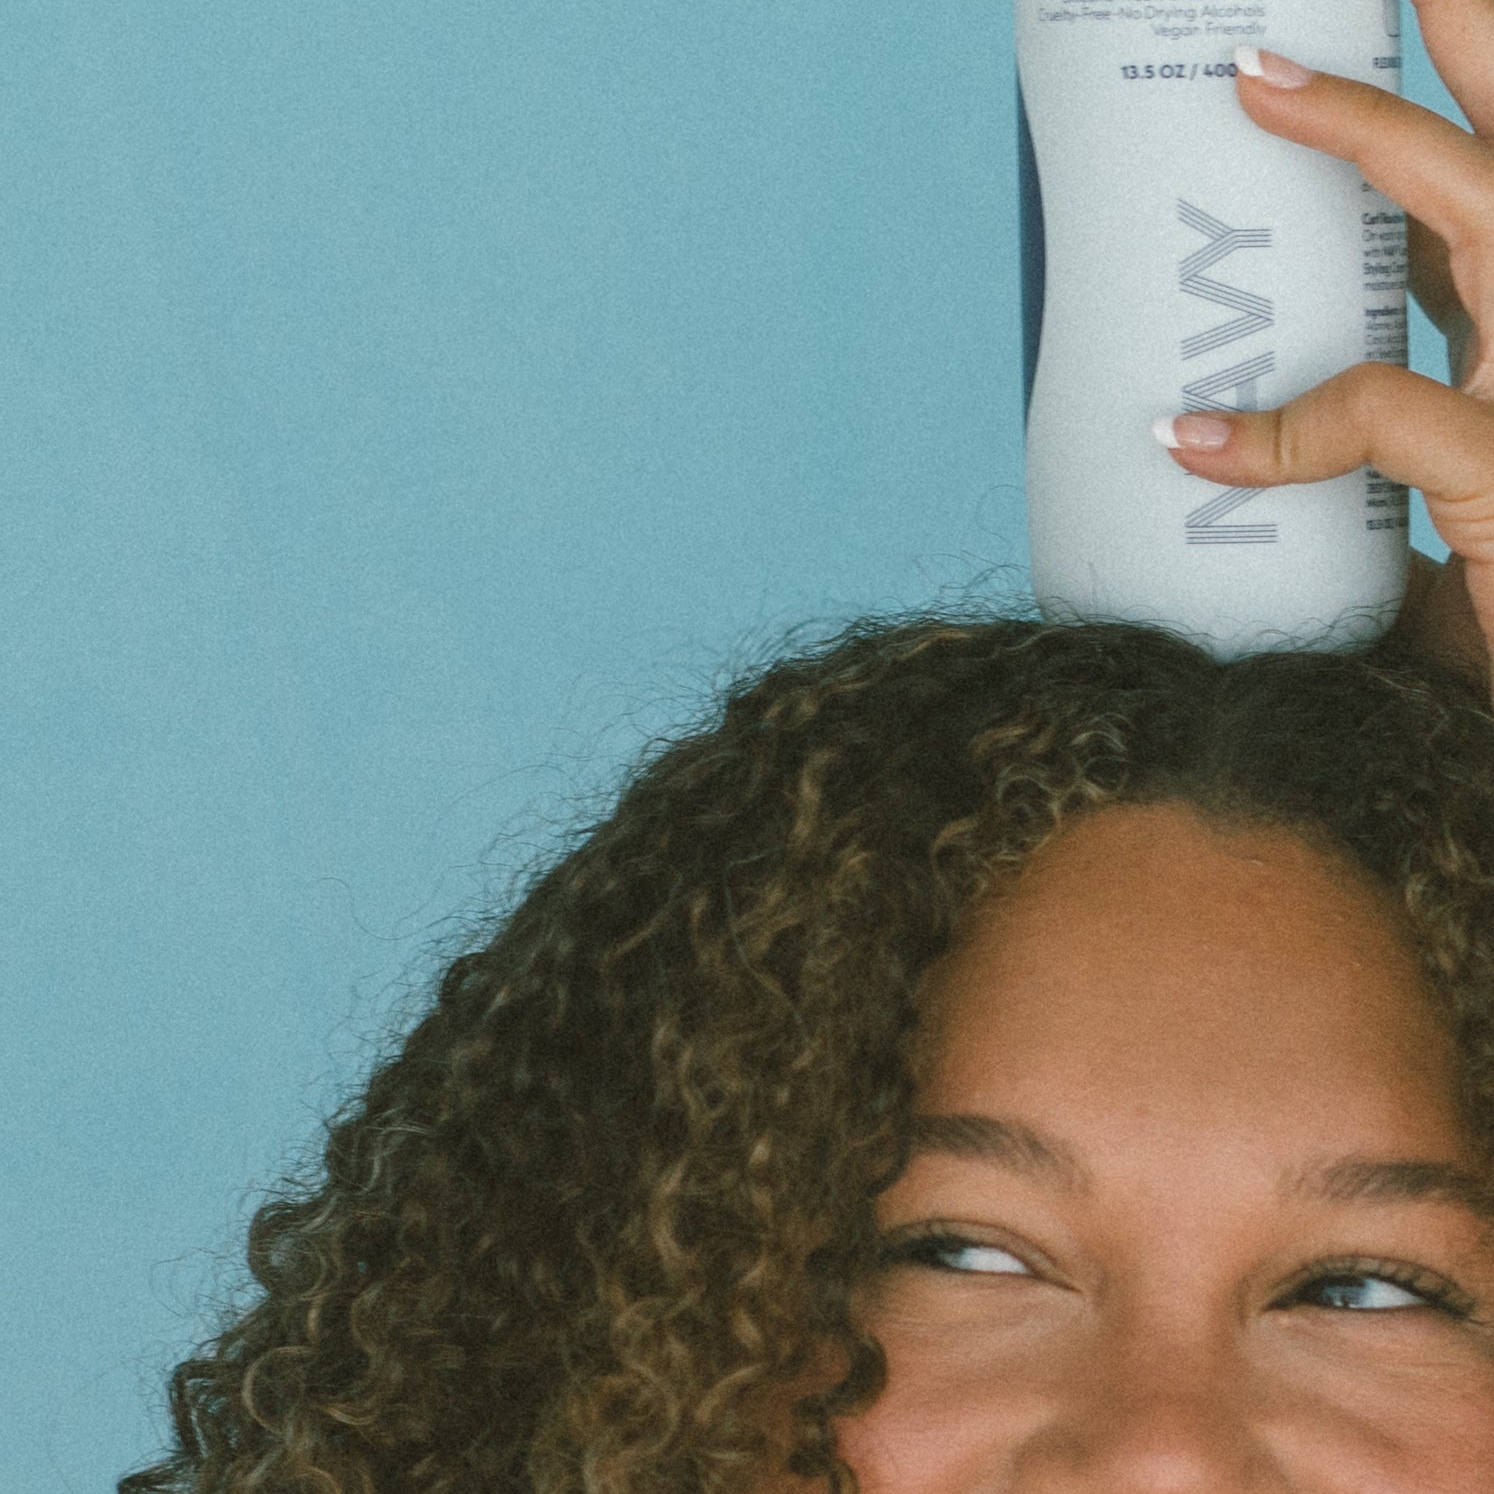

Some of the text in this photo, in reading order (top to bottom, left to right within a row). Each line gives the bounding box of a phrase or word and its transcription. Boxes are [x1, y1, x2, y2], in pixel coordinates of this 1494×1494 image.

[1144, 4, 1197, 22] Drying
[1201, 3, 1266, 18] Alcohols
[1151, 21, 1268, 40] Vegan Friendly
[1120, 63, 1155, 80] 13.5
[1159, 63, 1186, 79] OZ
[1189, 62, 1199, 81] /
